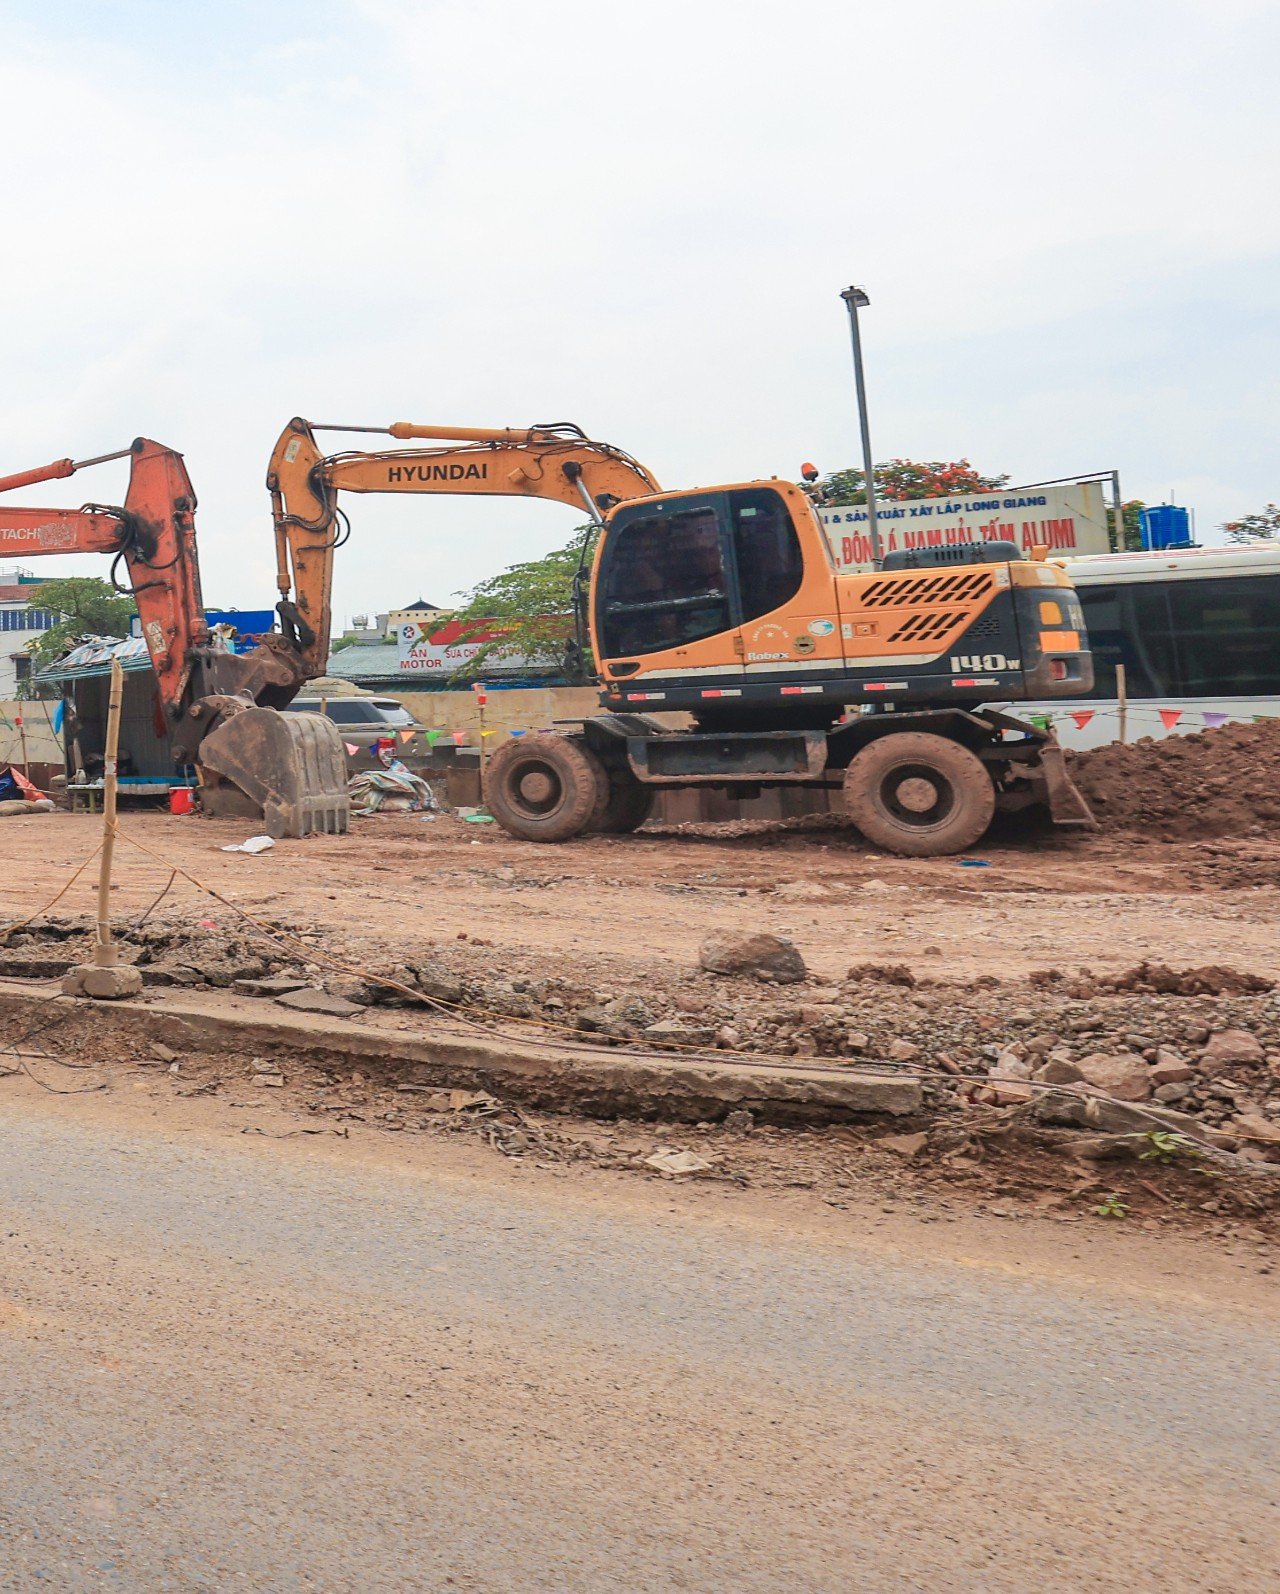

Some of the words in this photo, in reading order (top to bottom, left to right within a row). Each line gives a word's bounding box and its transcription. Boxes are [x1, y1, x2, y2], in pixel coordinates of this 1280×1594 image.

[388, 463, 487, 482] HYUNDAI
[832, 514, 841, 524] &
[966, 500, 1000, 512] LONG
[1004, 496, 1047, 509] GIANG
[904, 529, 941, 549] NAM
[411, 649, 427, 658] AN
[748, 652, 790, 660] Robex
[400, 659, 442, 668] MOTOR
